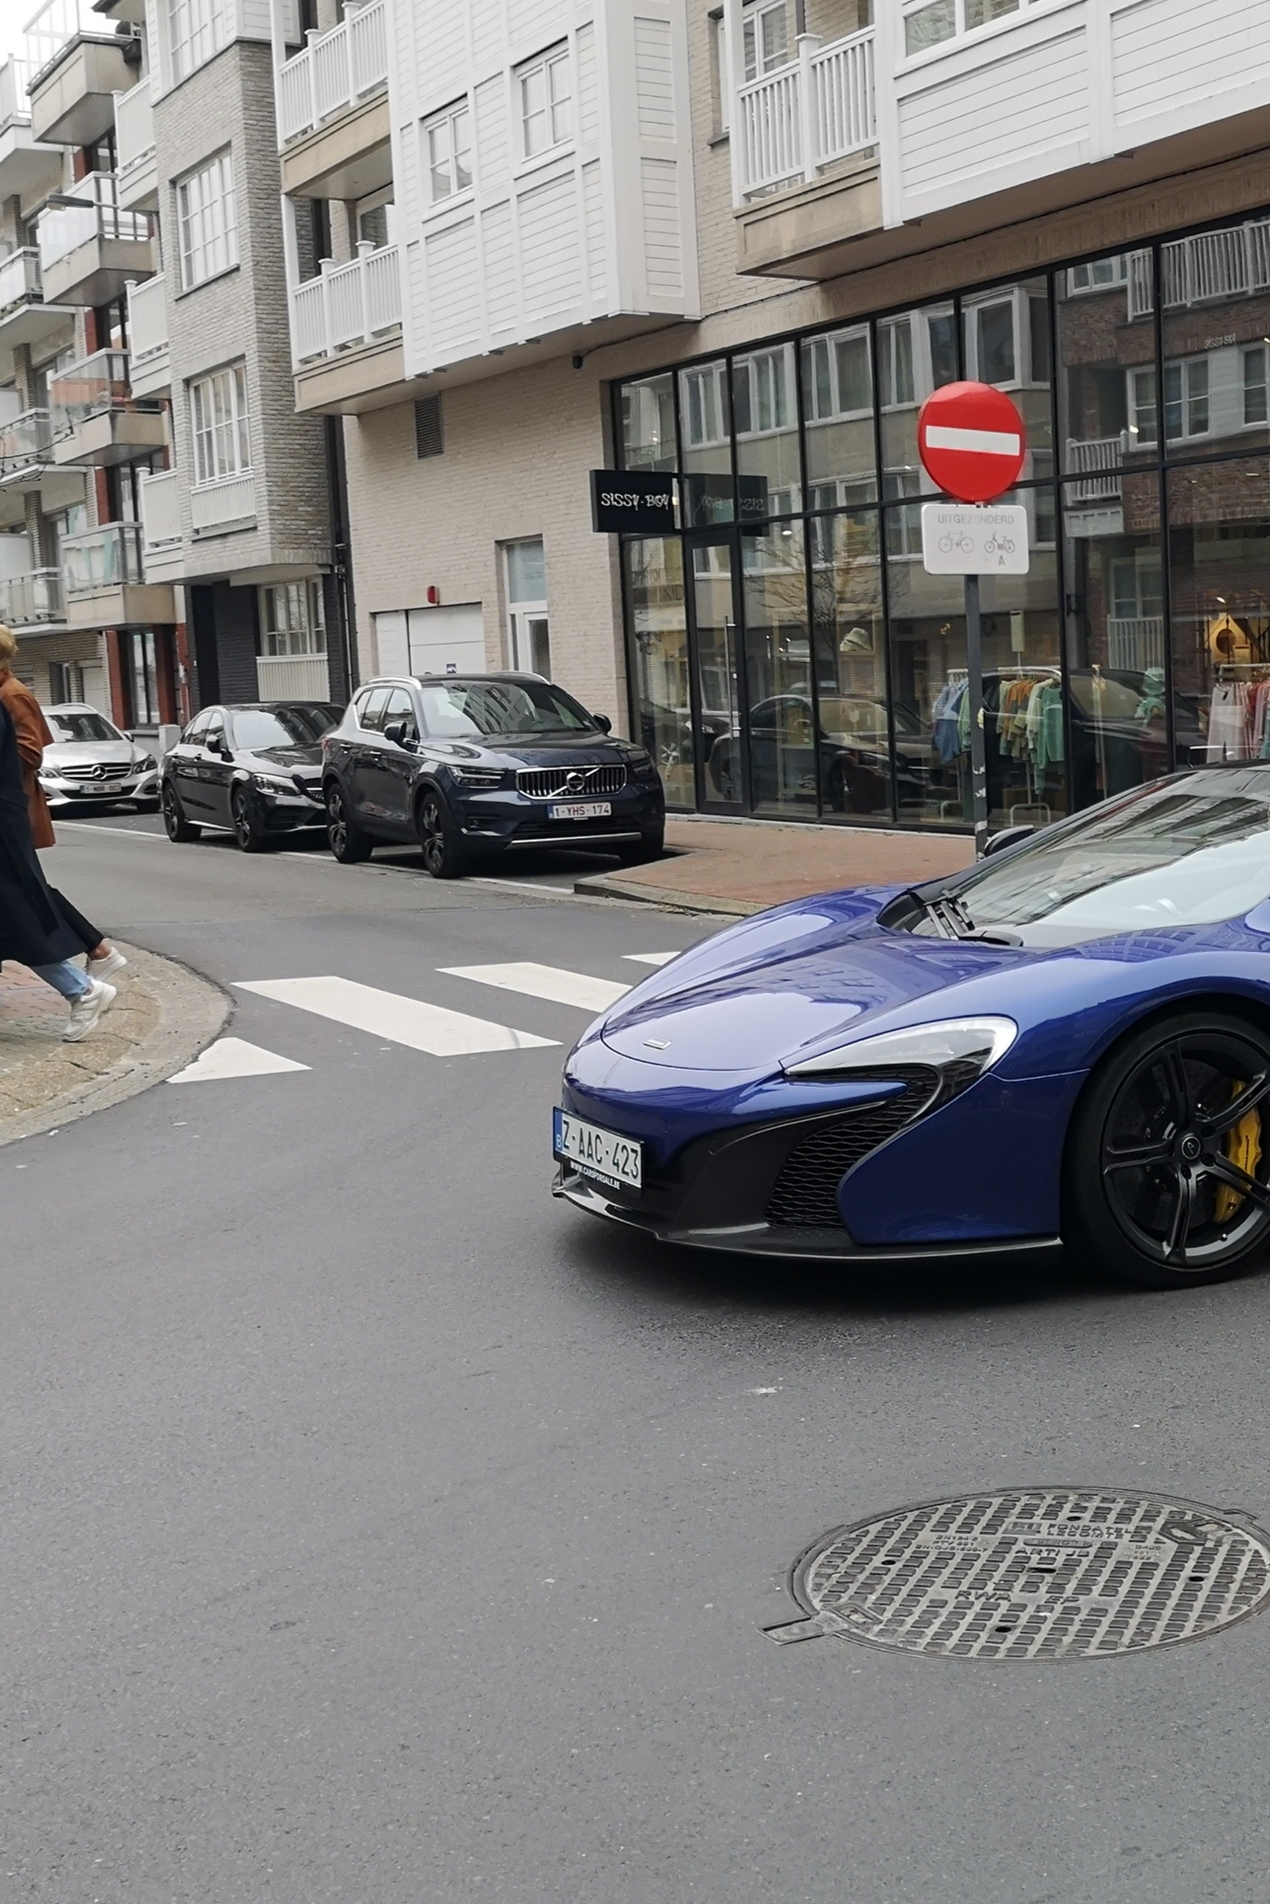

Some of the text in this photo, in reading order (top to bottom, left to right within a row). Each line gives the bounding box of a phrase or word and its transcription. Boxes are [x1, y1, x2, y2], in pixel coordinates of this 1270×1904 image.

[601, 492, 670, 511] SISSY-BOY
[938, 514, 1015, 525] UITGEZONDERD
[998, 555, 1006, 566] A
[555, 804, 610, 818] 1-YHS-174
[563, 1120, 639, 1179] Z-AAC-423
[954, 1590, 1012, 1603] RWA
